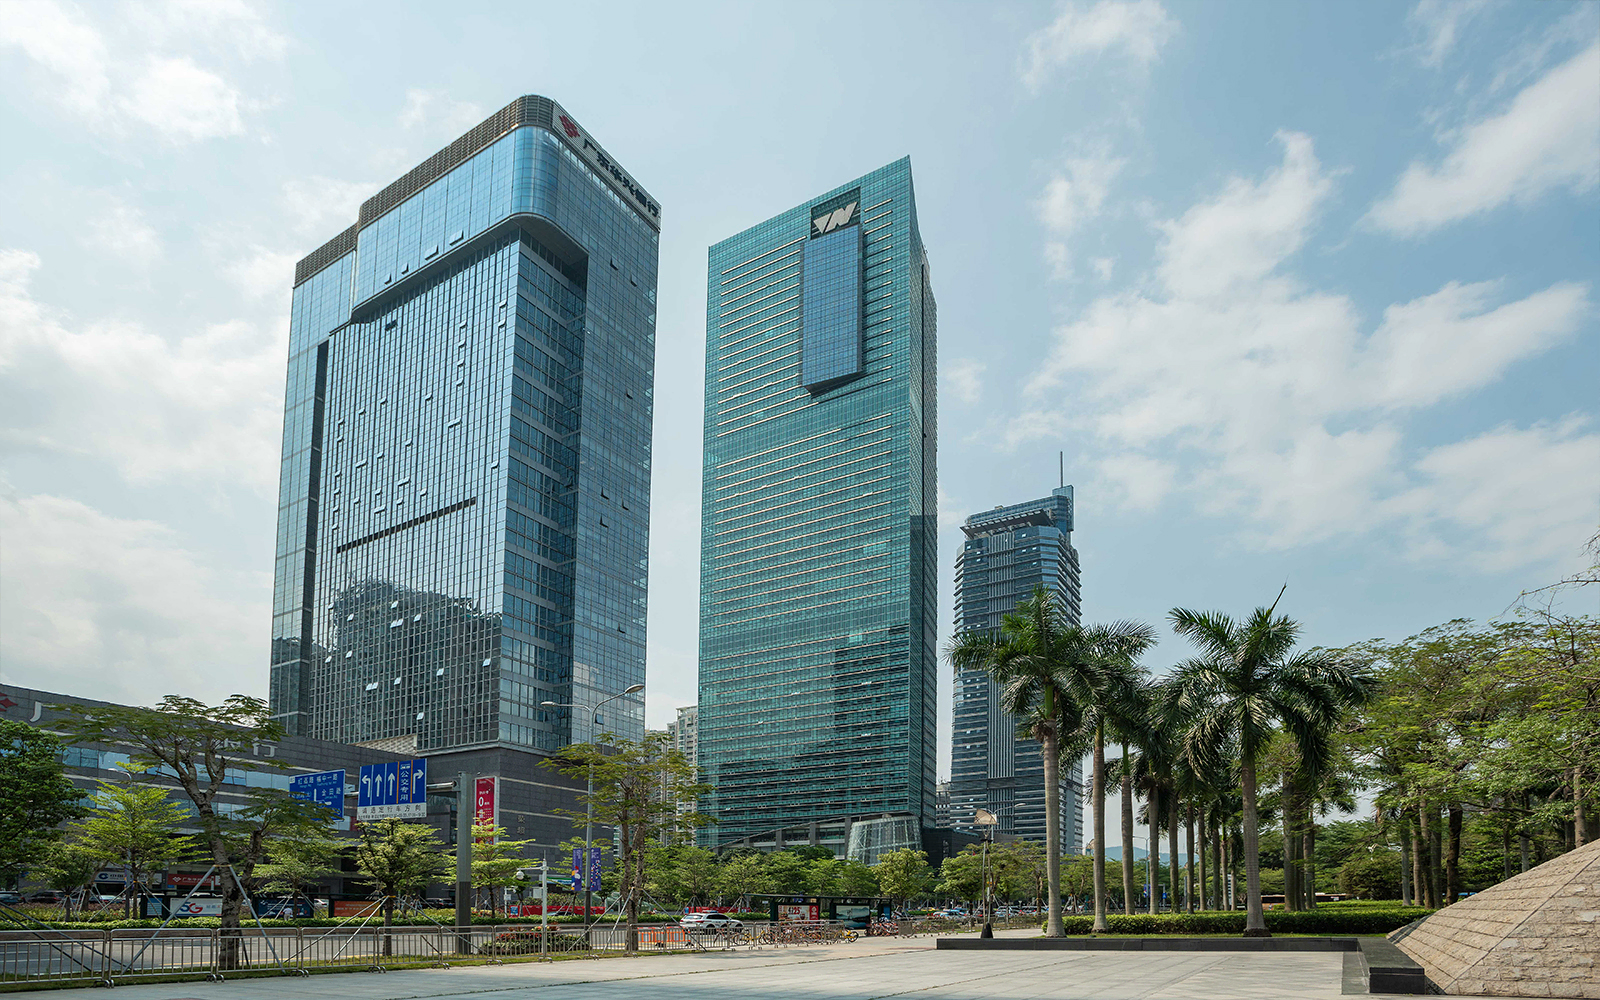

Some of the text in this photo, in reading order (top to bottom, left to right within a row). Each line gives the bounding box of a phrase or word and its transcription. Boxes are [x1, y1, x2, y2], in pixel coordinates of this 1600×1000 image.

[400, 770, 409, 801] 公交专用
[180, 901, 203, 914] 5G
